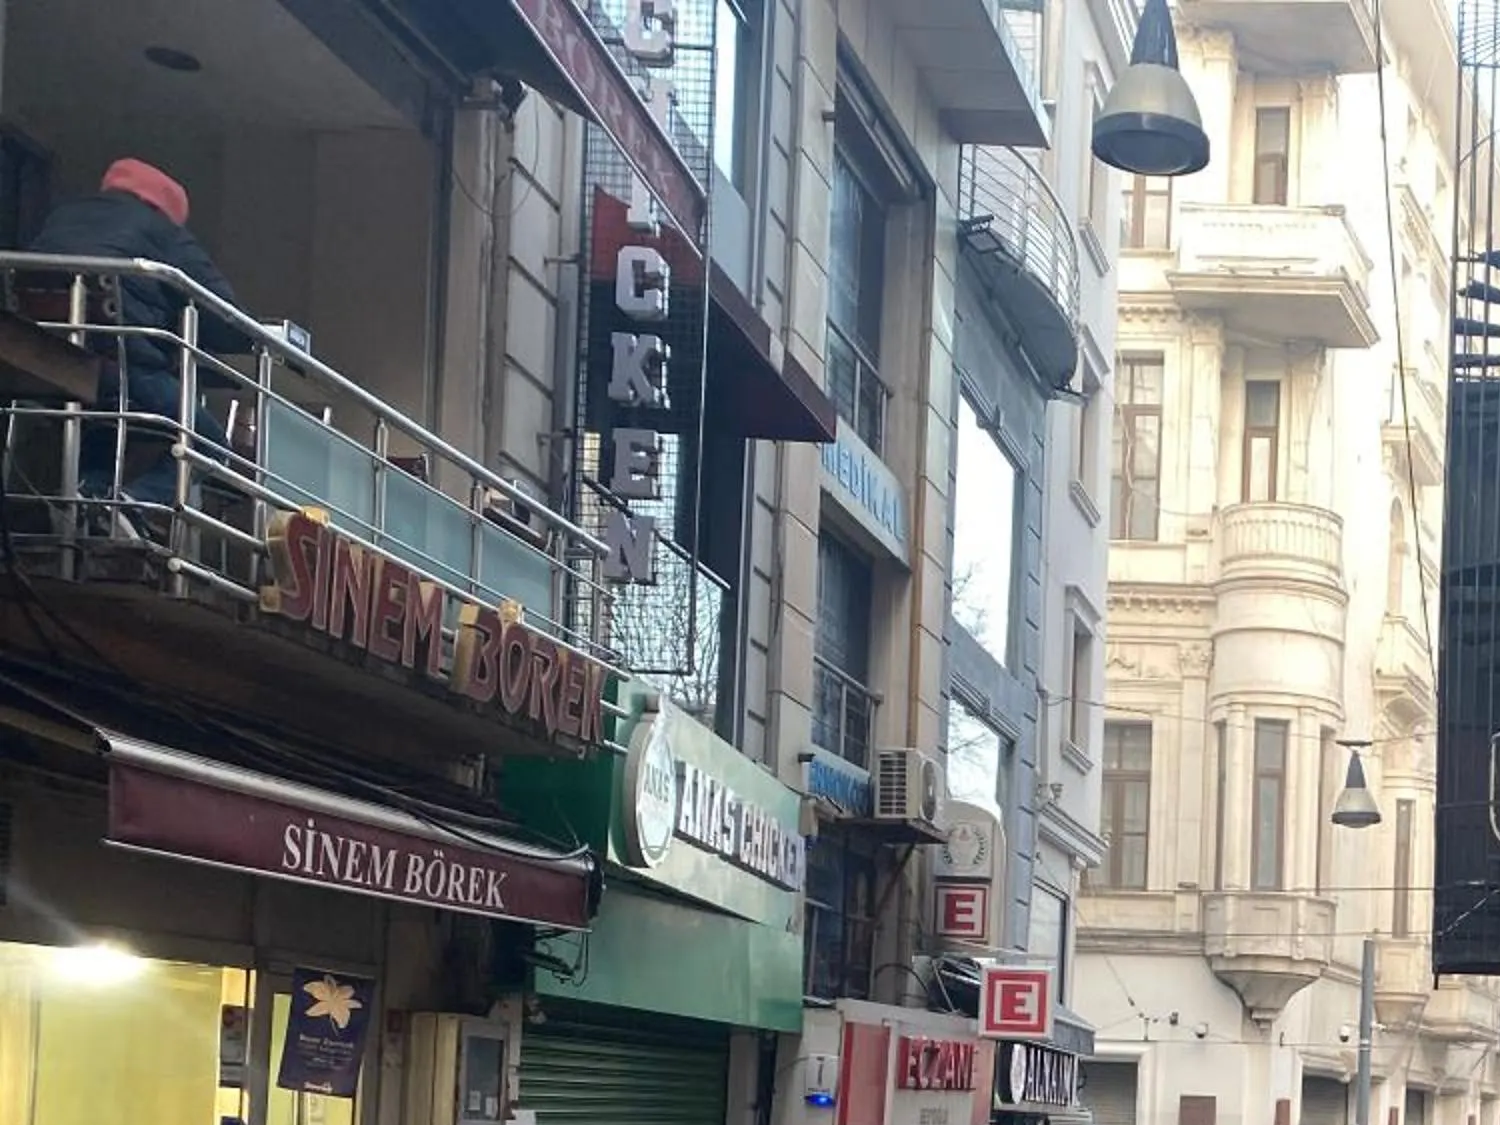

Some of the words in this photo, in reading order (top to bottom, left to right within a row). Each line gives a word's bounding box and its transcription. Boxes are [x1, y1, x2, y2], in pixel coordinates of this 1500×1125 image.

[679, 762, 736, 855] ANAS
[282, 817, 398, 889] SİNEM
[403, 849, 508, 909] BÖREK
[943, 893, 976, 931] E
[999, 983, 1033, 1022] E
